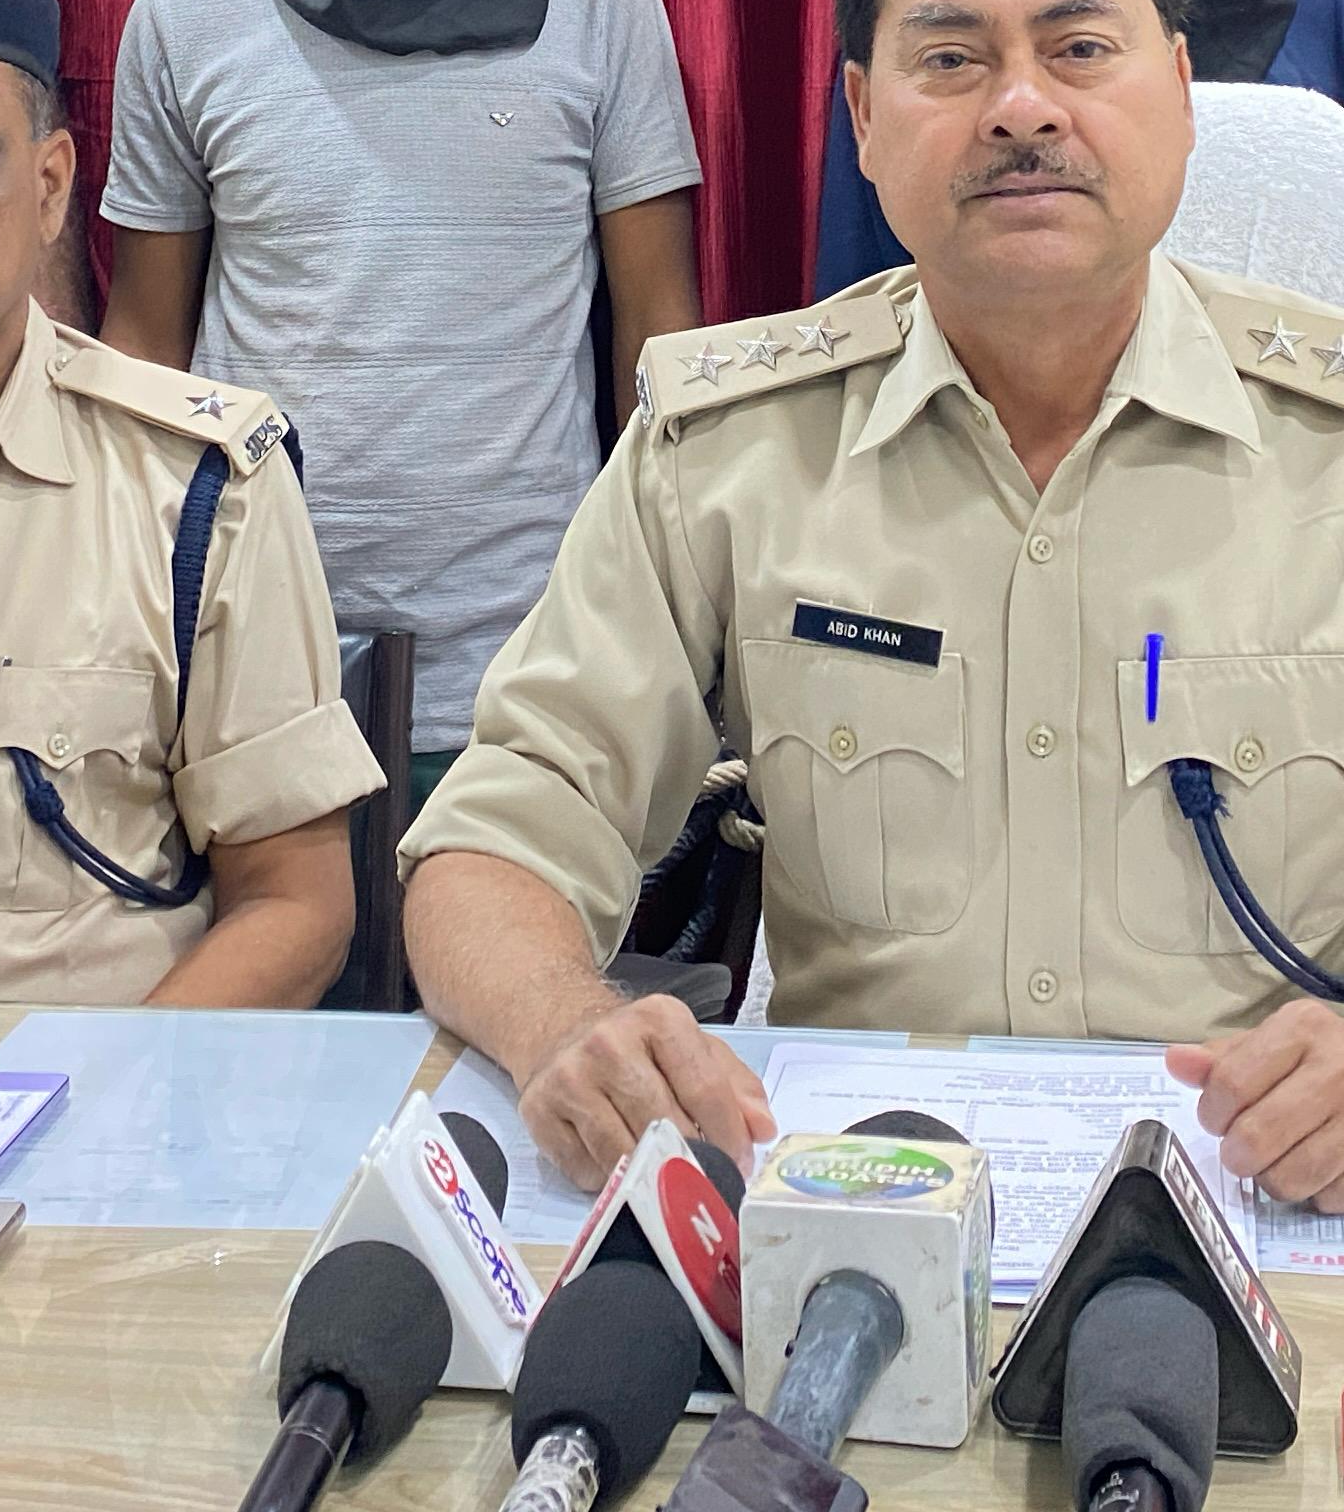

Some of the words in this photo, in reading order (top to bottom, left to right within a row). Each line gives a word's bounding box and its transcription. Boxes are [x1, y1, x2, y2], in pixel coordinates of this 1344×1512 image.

[826, 620, 858, 639] ABID
[863, 627, 903, 647] KHAN
[1169, 1152, 1248, 1293] NEWS
